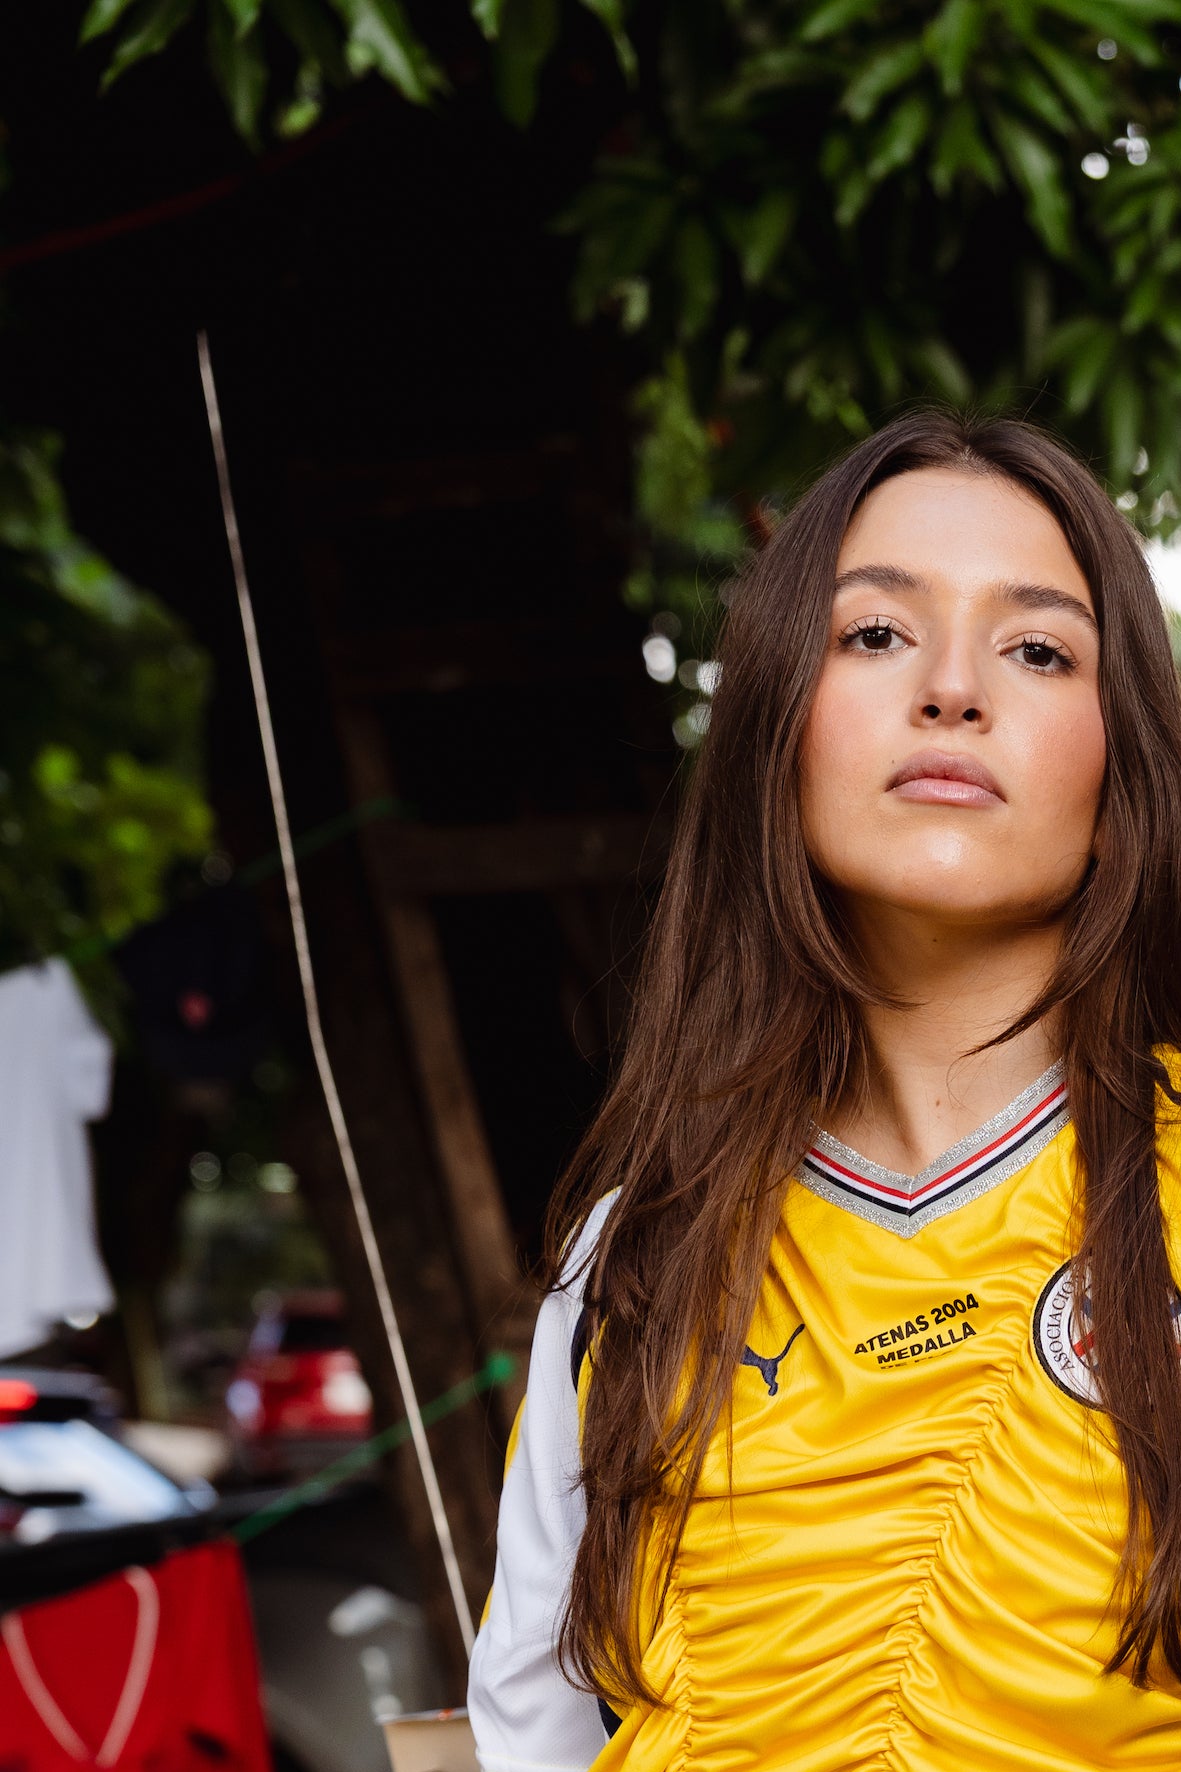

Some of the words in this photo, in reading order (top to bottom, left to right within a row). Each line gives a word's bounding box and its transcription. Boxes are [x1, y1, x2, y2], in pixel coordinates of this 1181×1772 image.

[854, 1314, 930, 1355] ATENAS
[930, 1293, 979, 1325] 2004
[877, 1321, 977, 1364] MEDALLA
